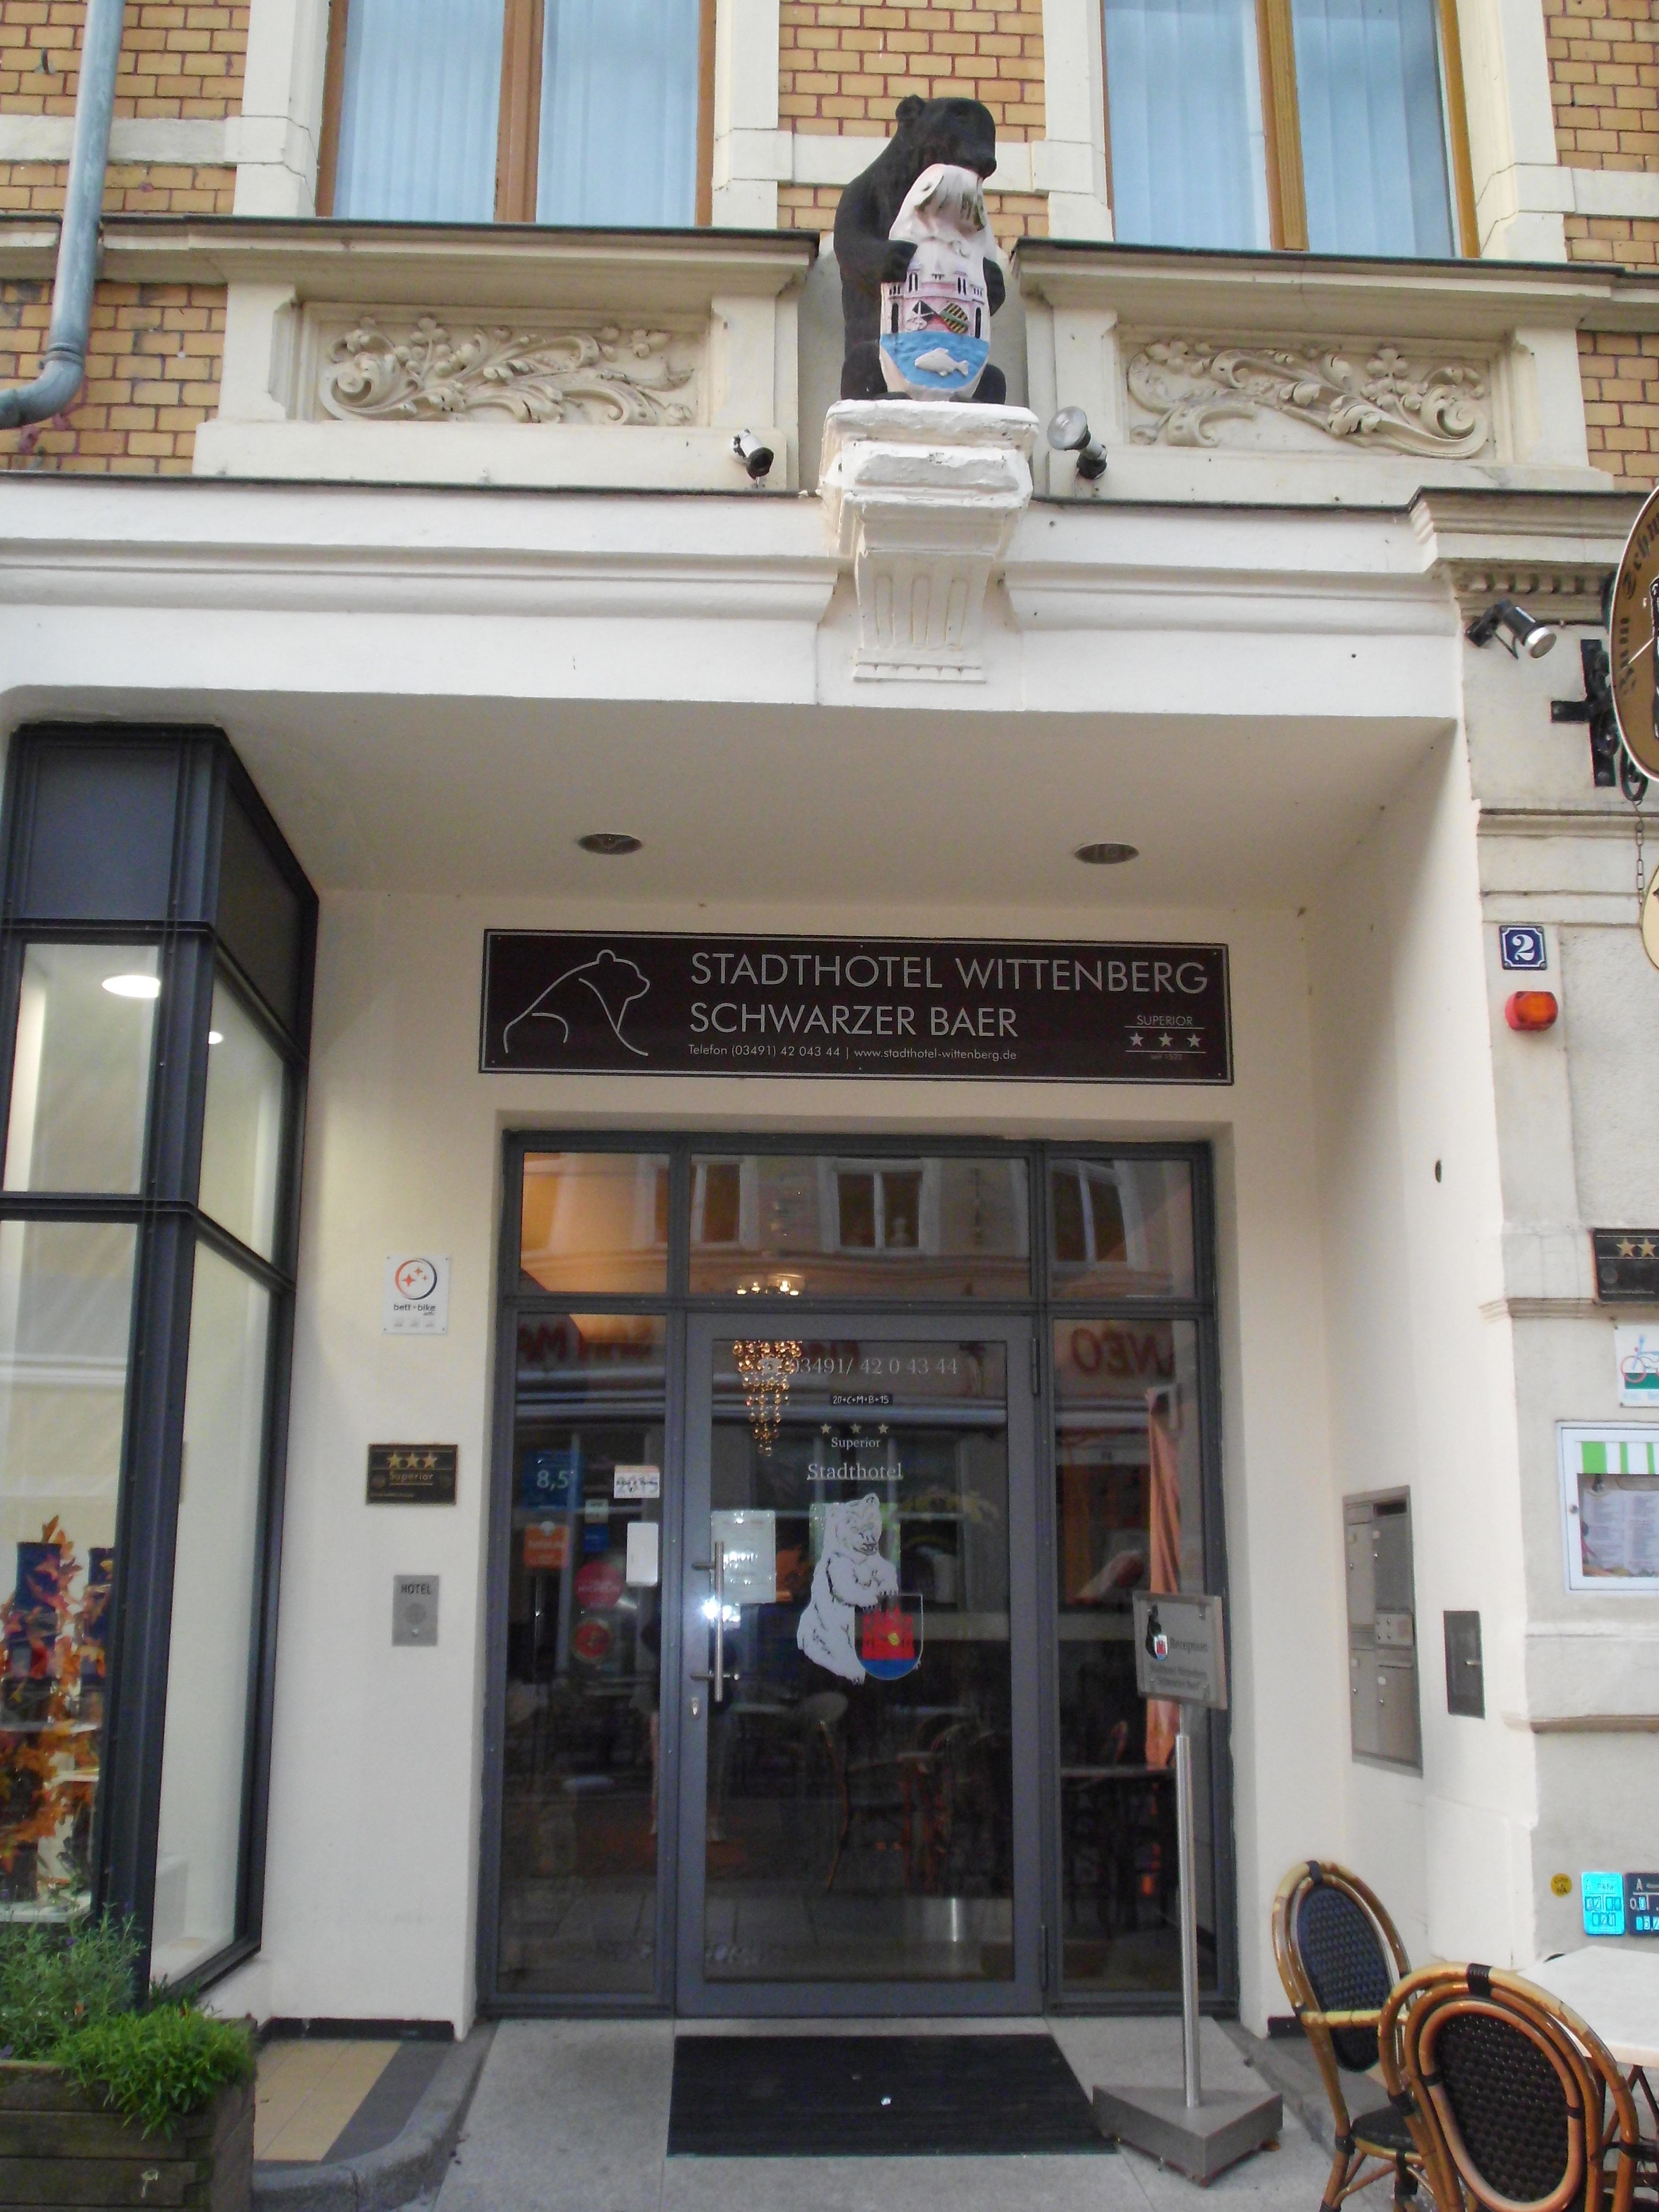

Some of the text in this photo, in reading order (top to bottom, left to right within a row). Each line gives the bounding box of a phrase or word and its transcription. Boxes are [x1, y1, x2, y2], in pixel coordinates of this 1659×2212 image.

[1512, 934, 1535, 961] 2
[691, 952, 1208, 994] STADTHOTEL WITTENBERG
[690, 1002, 1018, 1037] SCHWARZER BAER
[1137, 1014, 1194, 1027] SUPERIOR
[688, 1044, 1017, 1061] Telefon (03491) 42 043 44 www.stadthotel-wittenberg.de
[860, 1358, 882, 1374] 42
[888, 1358, 900, 1374] 0
[907, 1358, 929, 1374] 43
[935, 1358, 958, 1375] 44
[831, 1437, 881, 1450] Superior
[808, 1462, 903, 1480] Stadthotel
[401, 1584, 431, 1594] HOTEL
